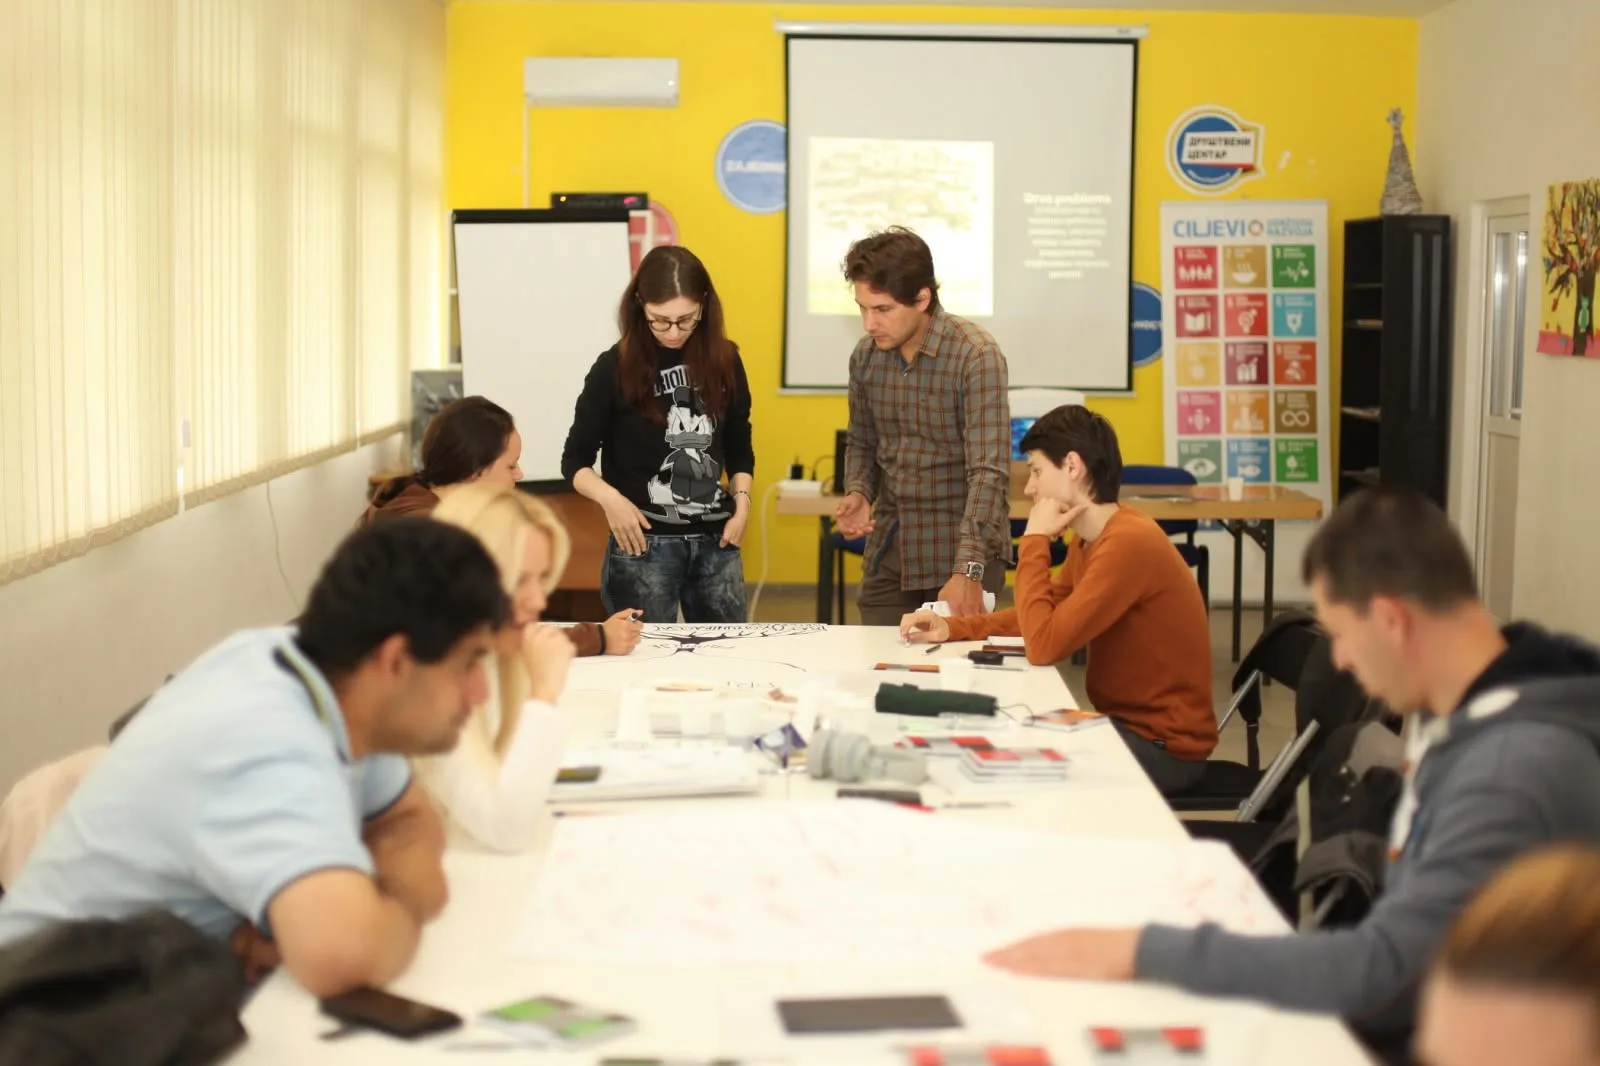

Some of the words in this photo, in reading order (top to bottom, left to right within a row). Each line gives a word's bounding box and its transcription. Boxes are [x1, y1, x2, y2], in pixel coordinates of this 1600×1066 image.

[1187, 136, 1252, 147] ДРУШТВЕНИ
[1187, 149, 1229, 160] ЦЕНТАР
[1173, 219, 1246, 238] CILJEVI
